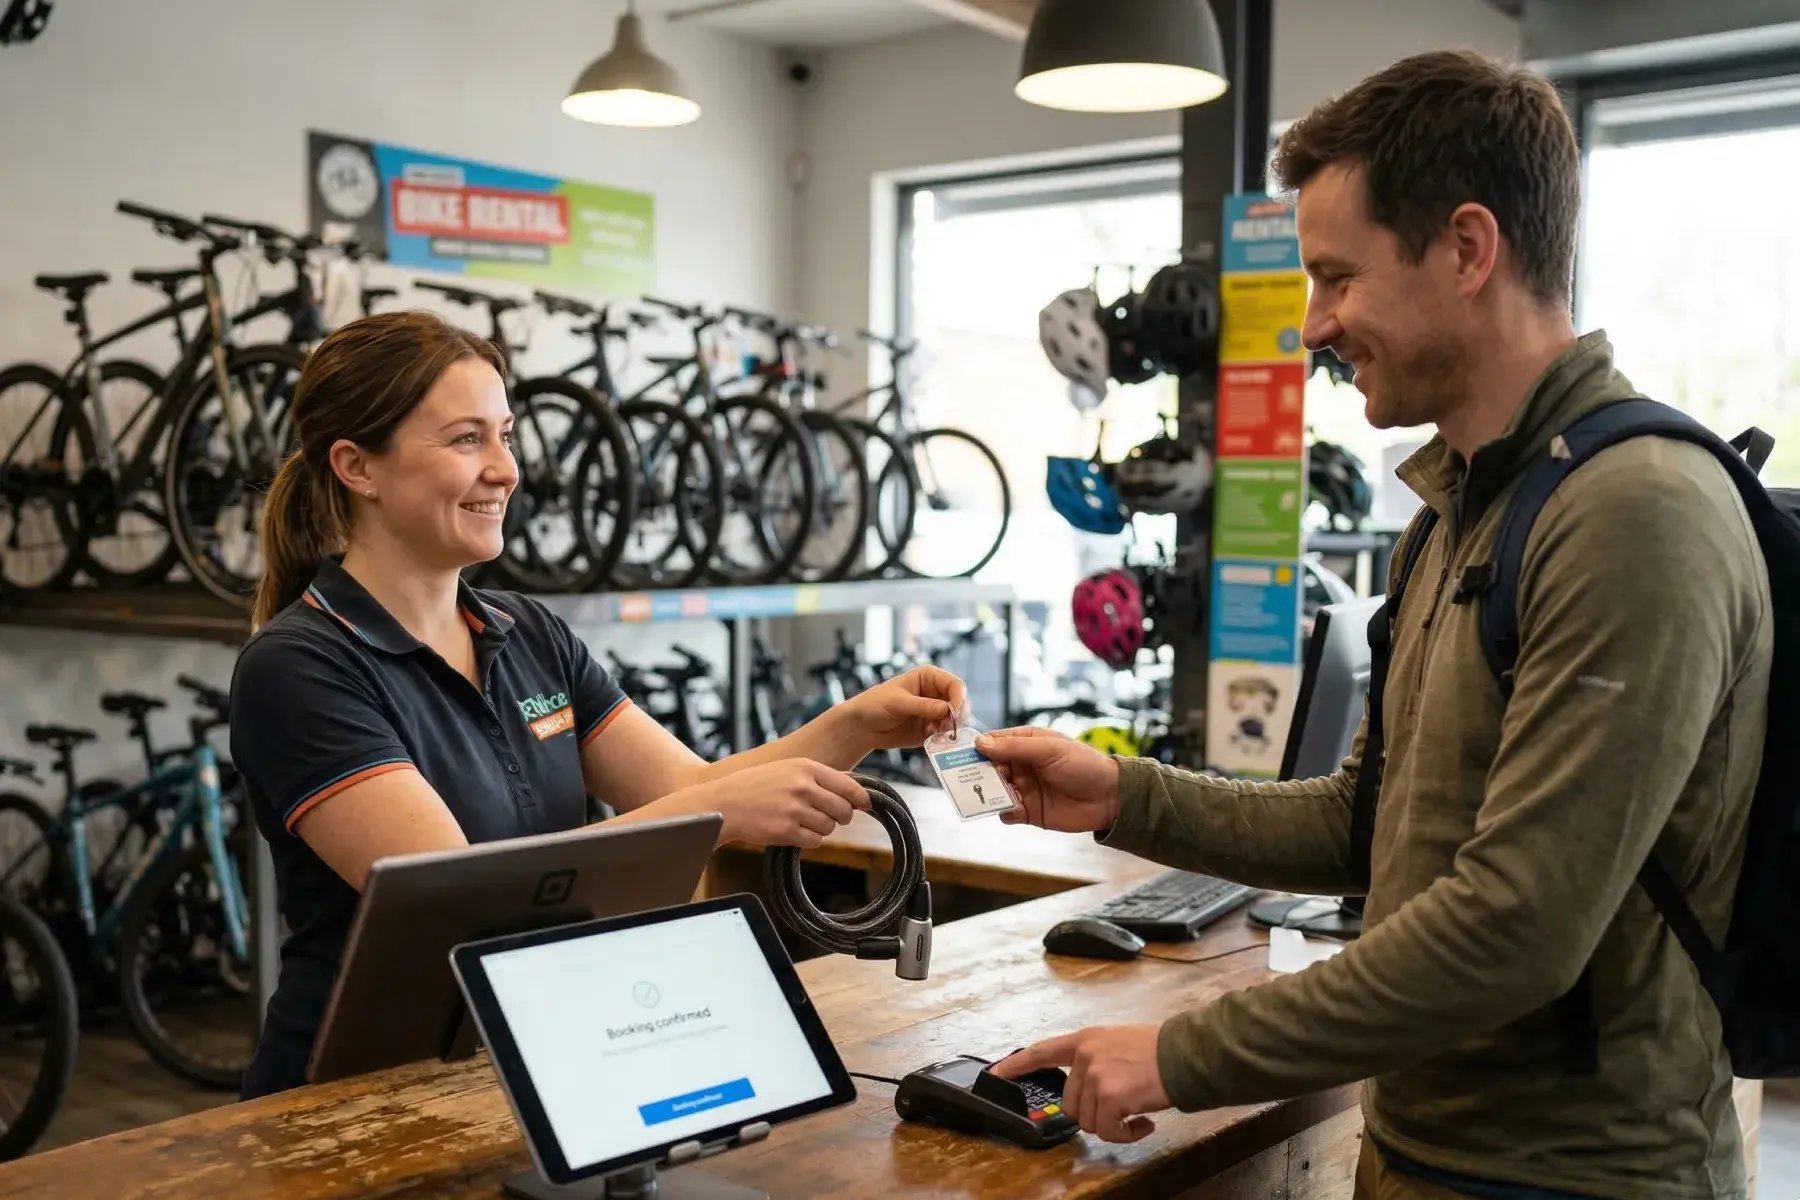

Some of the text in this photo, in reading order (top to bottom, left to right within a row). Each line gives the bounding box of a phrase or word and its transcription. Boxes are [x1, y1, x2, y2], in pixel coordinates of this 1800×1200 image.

[398, 188, 567, 237] BIKE RENTAL
[606, 1006, 711, 1039] Booking confirmed
